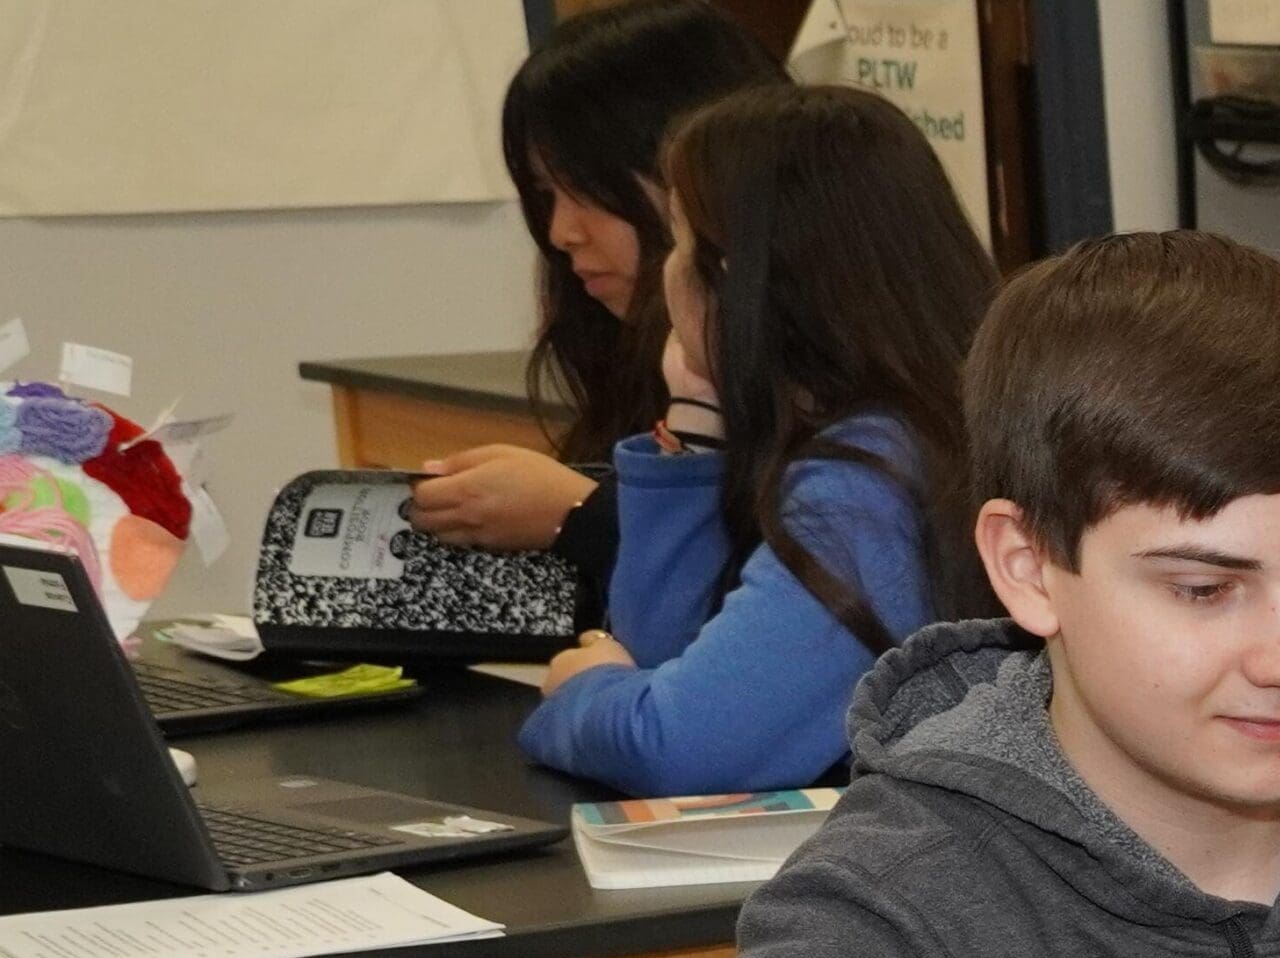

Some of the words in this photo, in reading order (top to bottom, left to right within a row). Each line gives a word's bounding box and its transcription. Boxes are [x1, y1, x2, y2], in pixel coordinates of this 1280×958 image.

[848, 24, 882, 46] oud
[887, 24, 905, 47] to
[858, 58, 917, 89] PLTW
